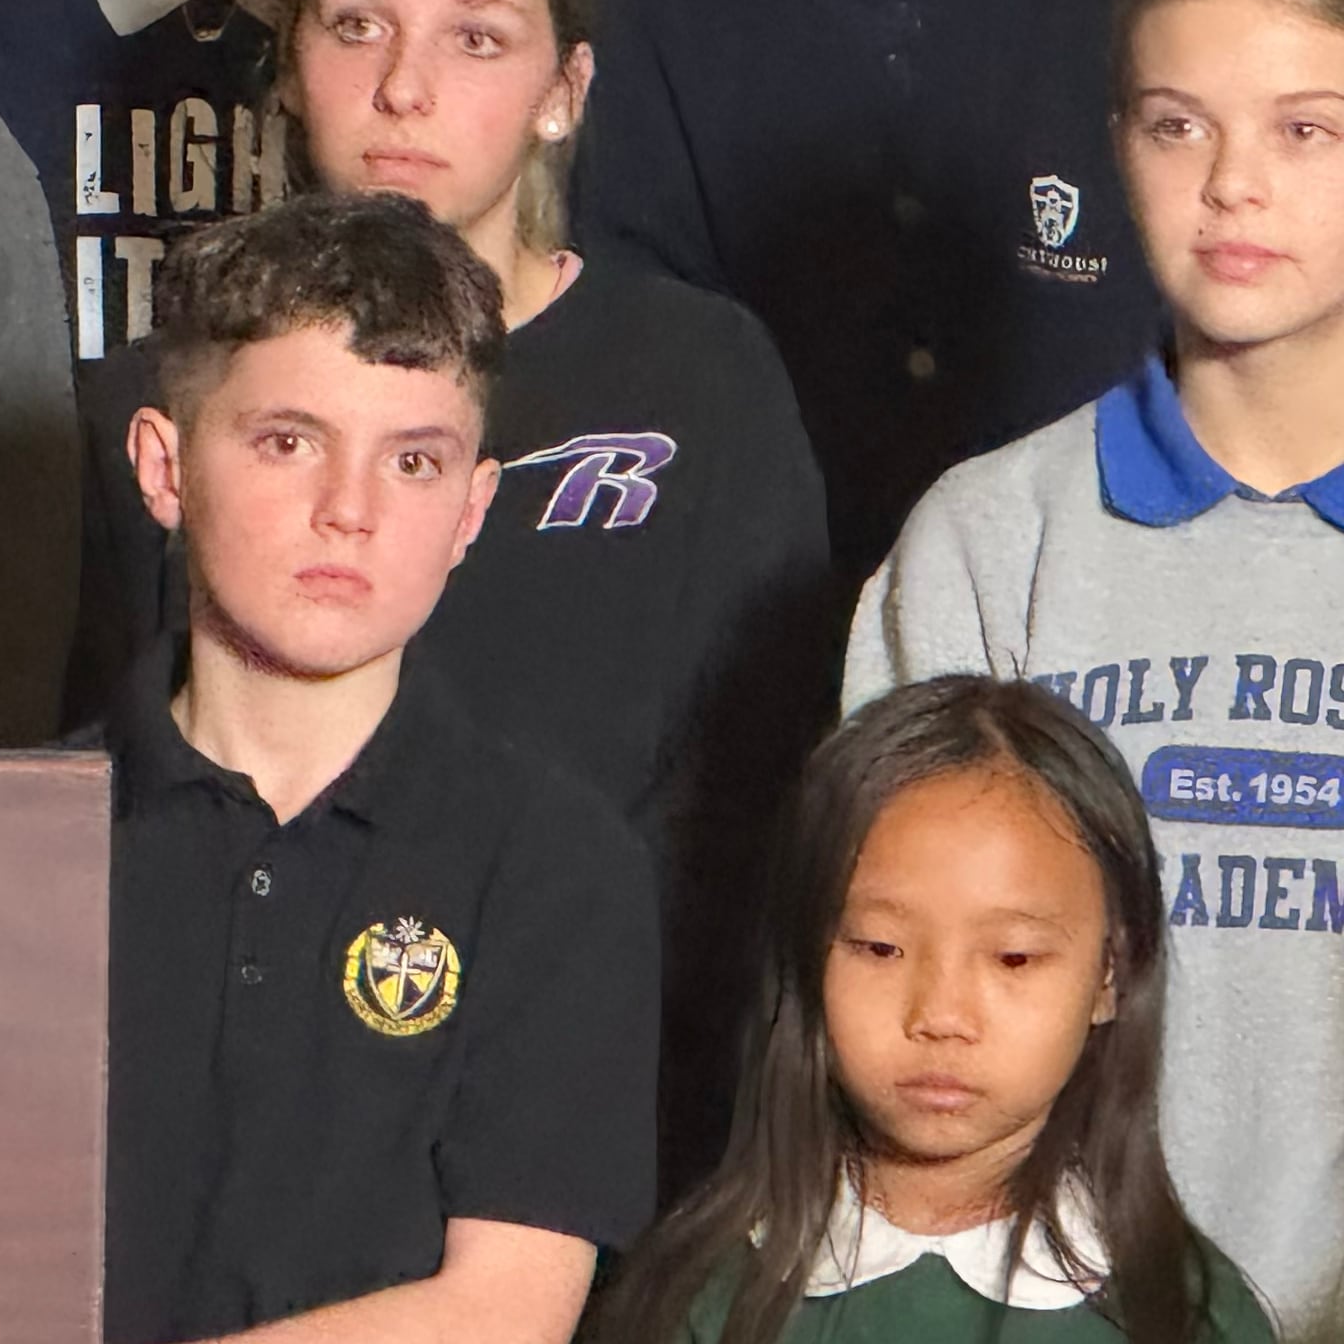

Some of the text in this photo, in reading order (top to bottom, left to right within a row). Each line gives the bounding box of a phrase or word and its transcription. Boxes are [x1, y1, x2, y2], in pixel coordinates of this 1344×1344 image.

[76, 236, 165, 359] IT
[1170, 768, 1341, 807] Est. 1954
[1169, 854, 1344, 933] ADEM
